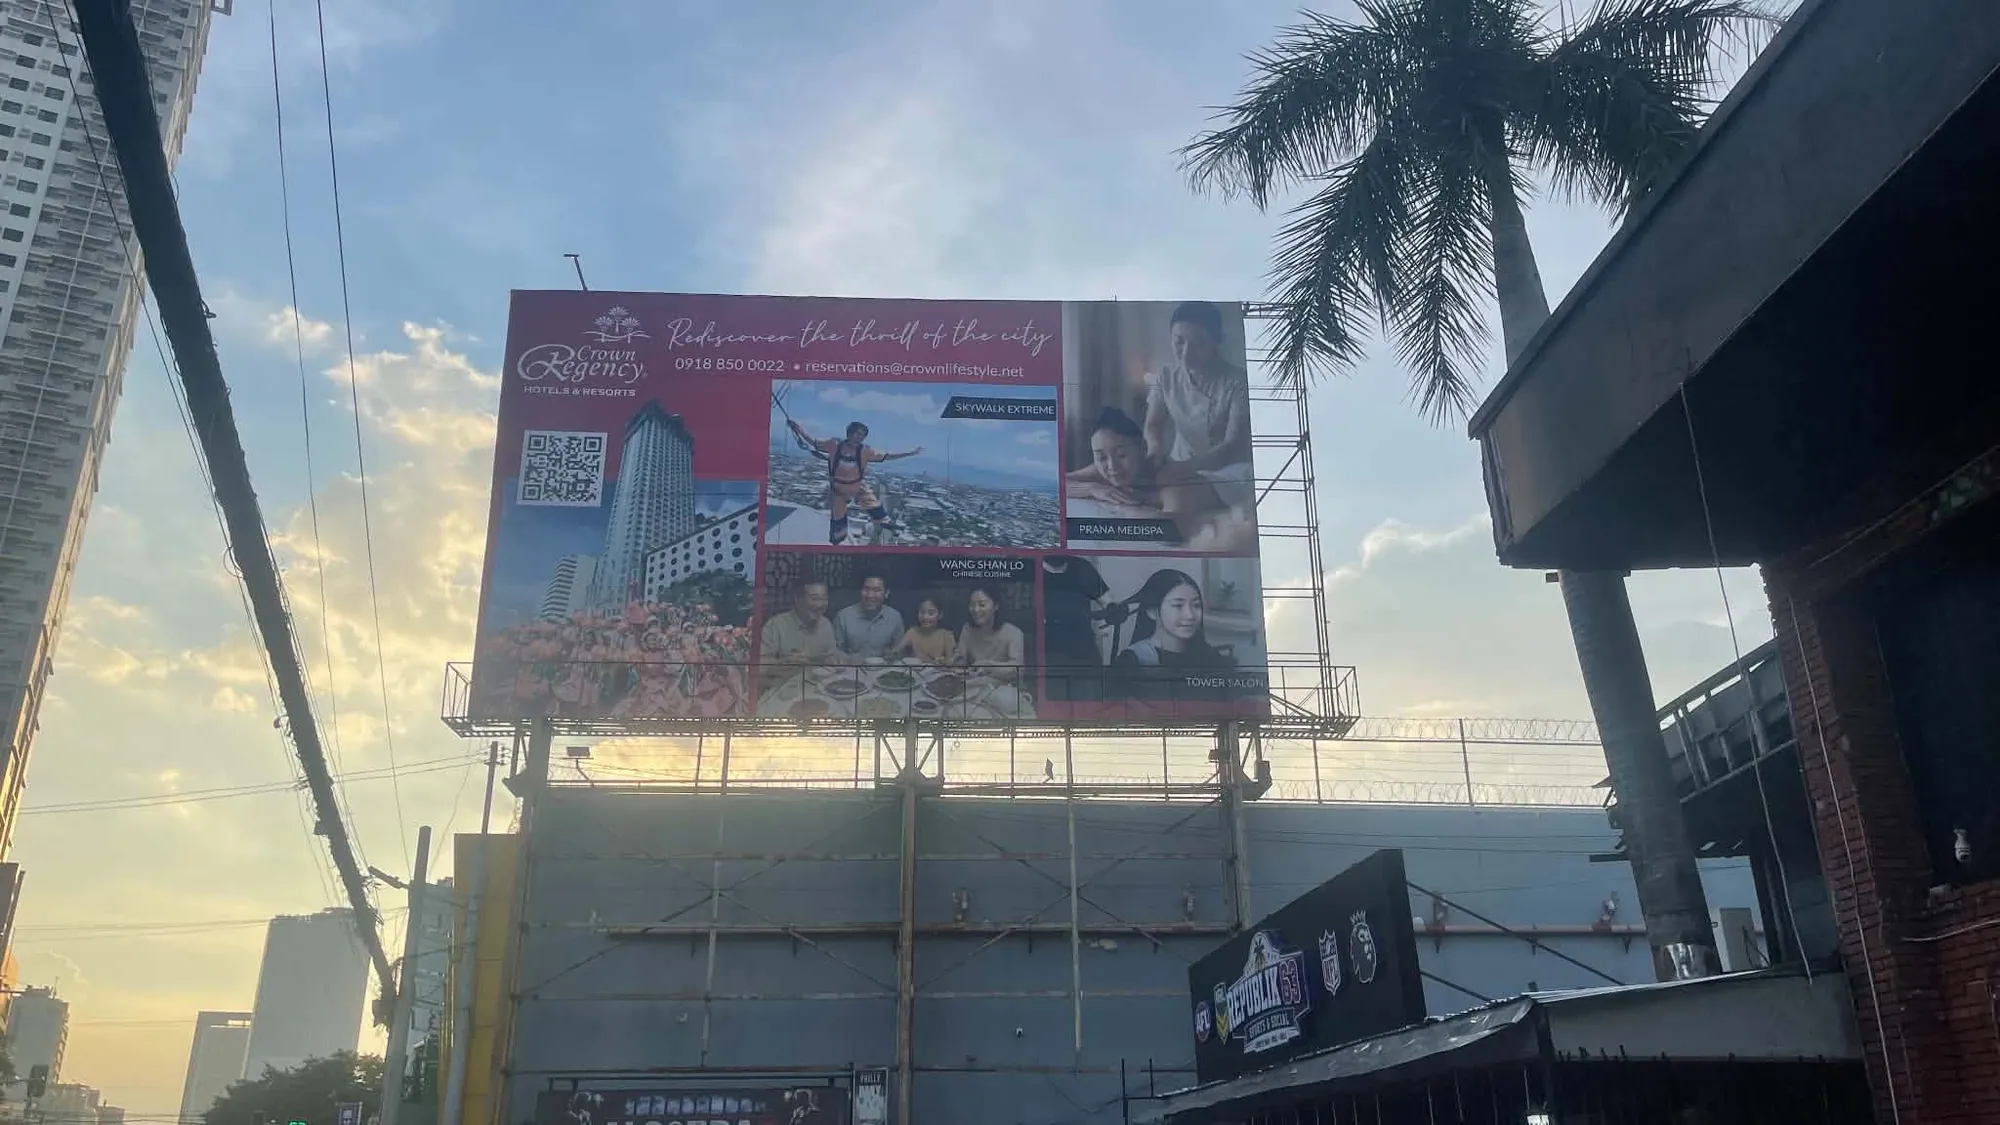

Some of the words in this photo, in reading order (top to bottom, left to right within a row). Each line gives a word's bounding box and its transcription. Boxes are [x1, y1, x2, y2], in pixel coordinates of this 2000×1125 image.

[667, 317, 794, 350] Rediscover
[799, 319, 845, 348] the
[850, 319, 920, 351] thrill
[923, 323, 948, 349] of
[952, 318, 996, 347] the
[1001, 319, 1053, 357] city
[577, 344, 636, 361] Crown
[517, 343, 644, 384] Regency
[675, 357, 711, 371] 0918
[716, 358, 744, 371] 850
[747, 358, 785, 372] 0022
[805, 359, 1025, 379] reservations@crownlifestyle.net
[523, 385, 570, 395] HOTELS
[572, 387, 581, 396] &
[582, 387, 636, 397] RESORTS
[955, 402, 1005, 414] SKYWALK
[1007, 404, 1055, 415] EXTREME
[1079, 524, 1116, 535] PRANA
[1117, 525, 1164, 536] MEDISPA
[940, 559, 976, 570] WANG
[977, 560, 1007, 570] SHAN
[1010, 560, 1024, 571] LO
[1185, 676, 1226, 687] TOWER
[1226, 965, 1282, 1034] REPUBLIK
[1196, 1007, 1210, 1034] AFL
